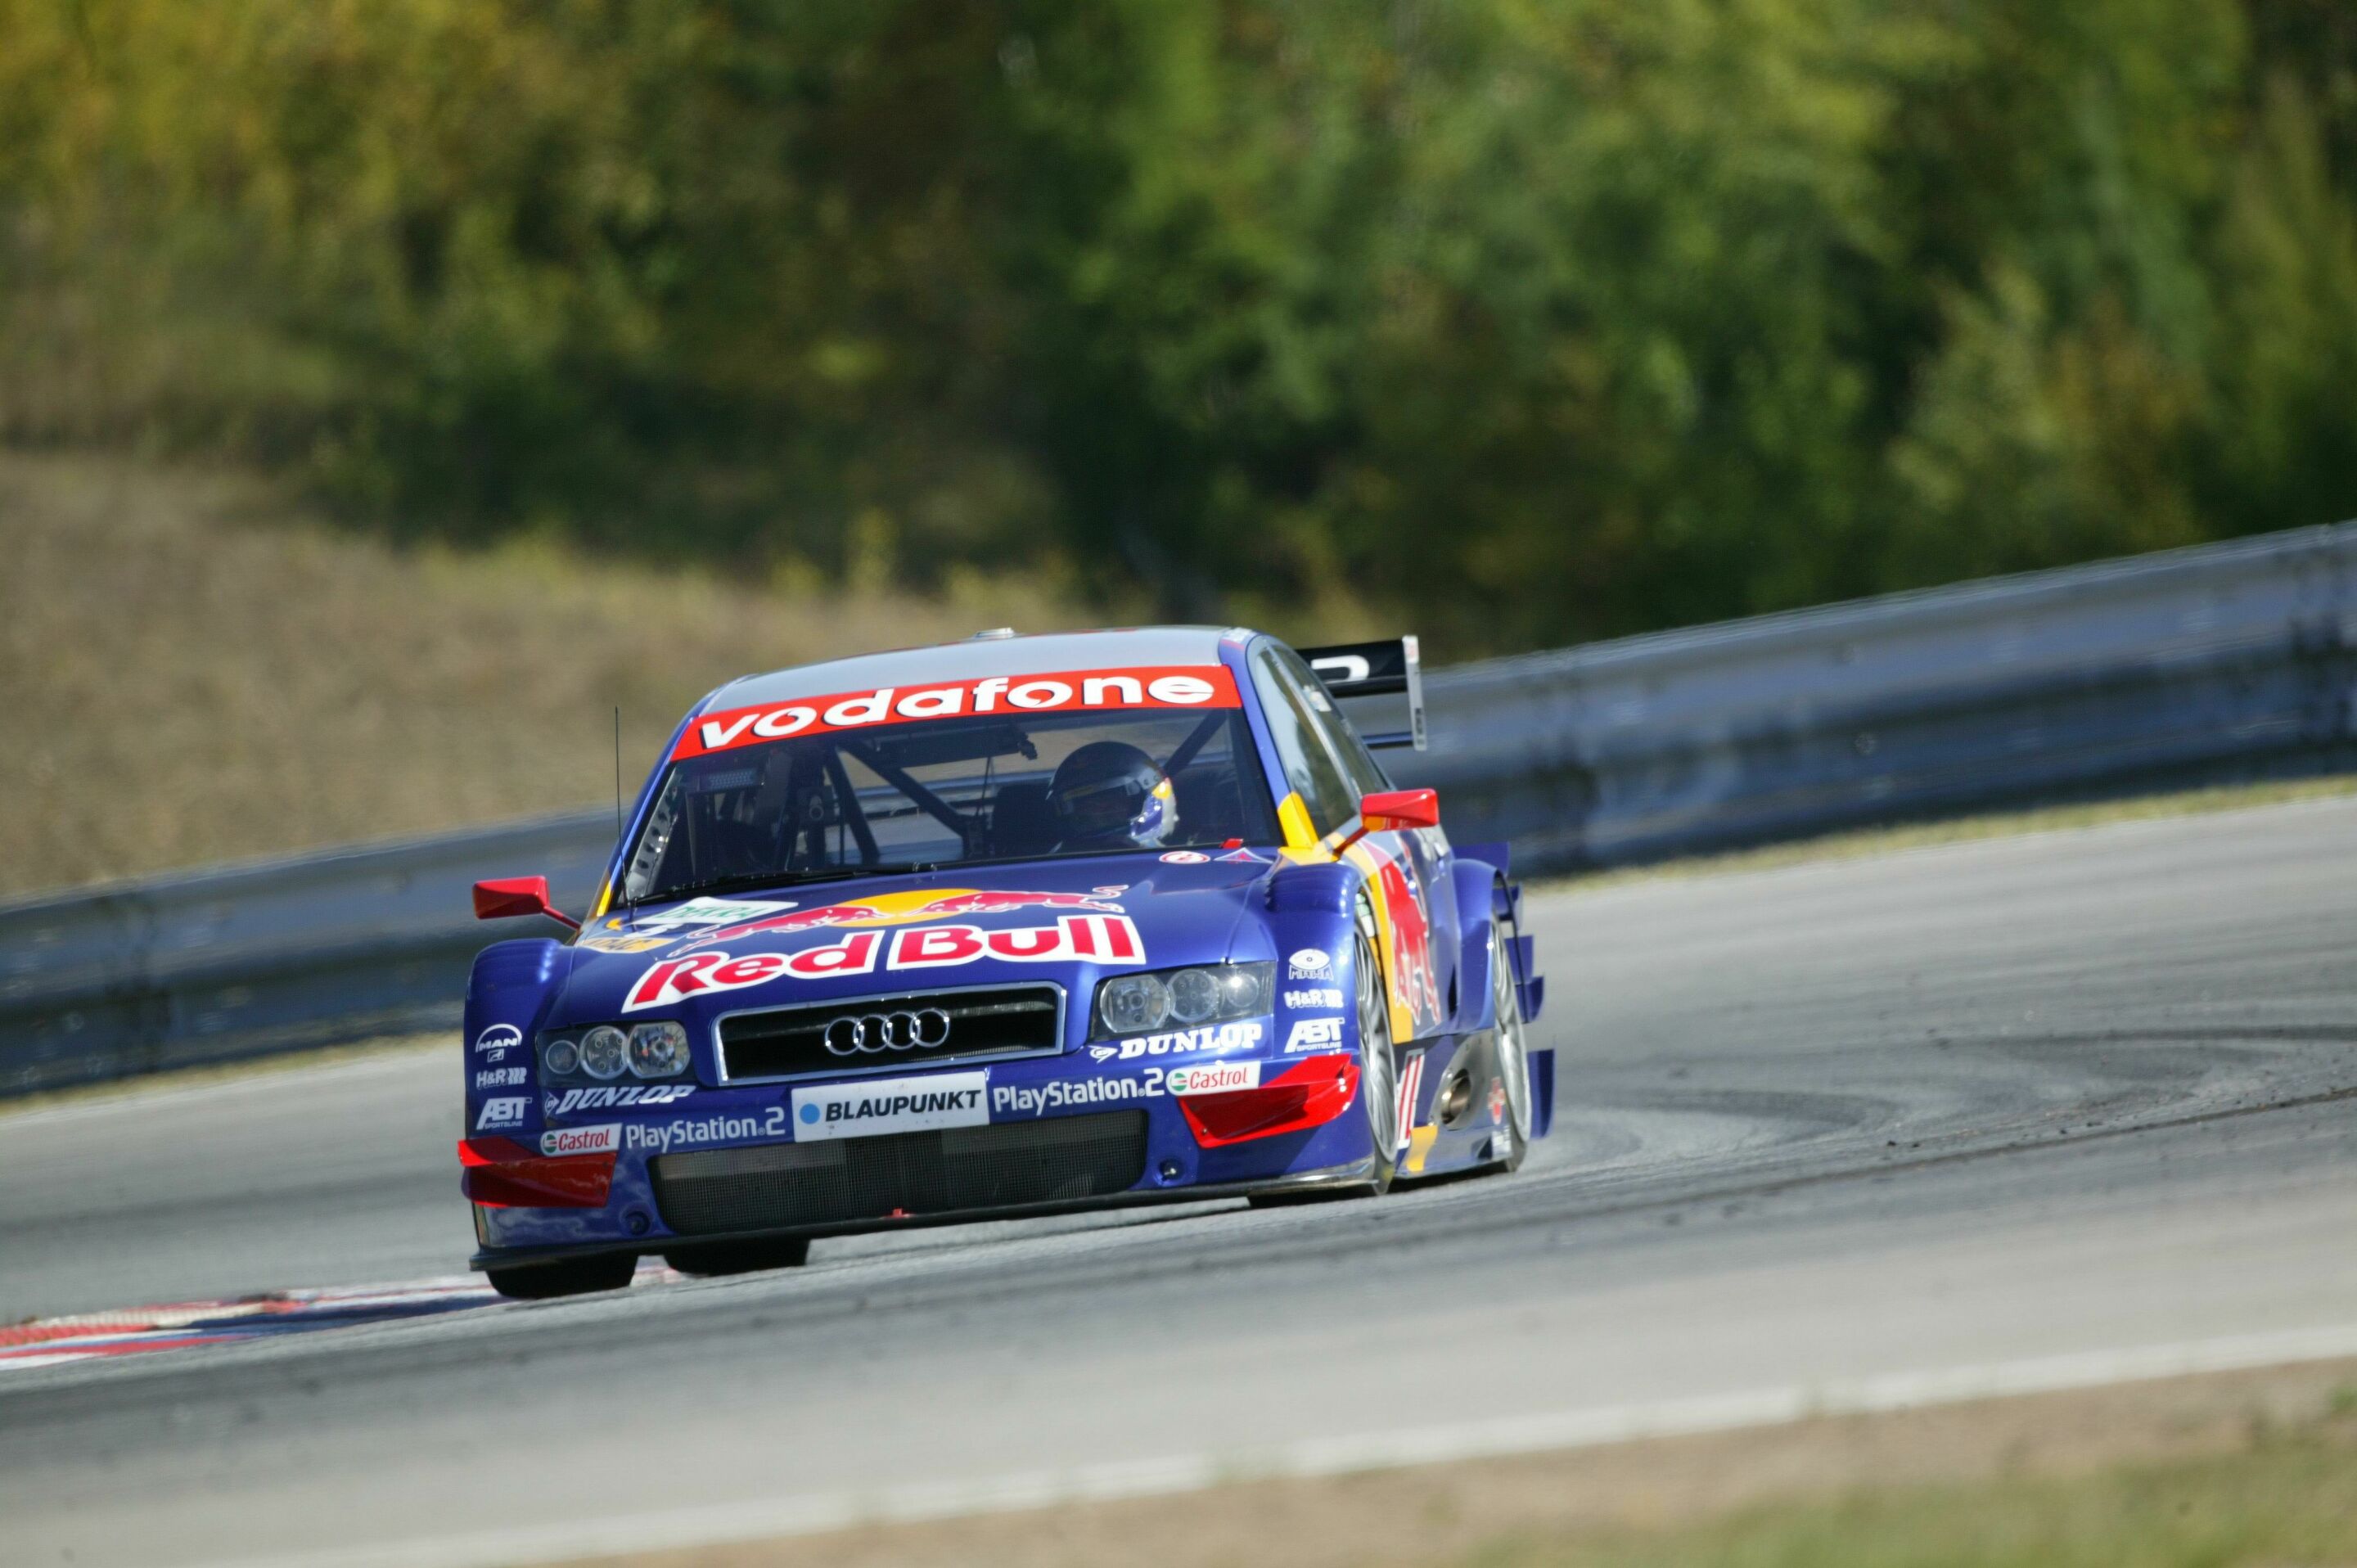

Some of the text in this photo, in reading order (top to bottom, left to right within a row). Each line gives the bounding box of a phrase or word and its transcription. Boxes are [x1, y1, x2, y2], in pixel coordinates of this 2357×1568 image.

[701, 676, 1215, 750] vodafone
[622, 914, 1146, 1013] Red Bull
[479, 1038, 518, 1052] MAN
[1118, 1024, 1262, 1059] DUNLOP
[1284, 1017, 1345, 1053] ABT
[476, 1068, 507, 1089] H&R
[1190, 1066, 1249, 1089] Castrol
[476, 1097, 526, 1130] ABT
[556, 1085, 696, 1115] DUNLOP
[825, 1089, 981, 1122] BLAUPUNKT
[558, 1129, 610, 1151] Castrol
